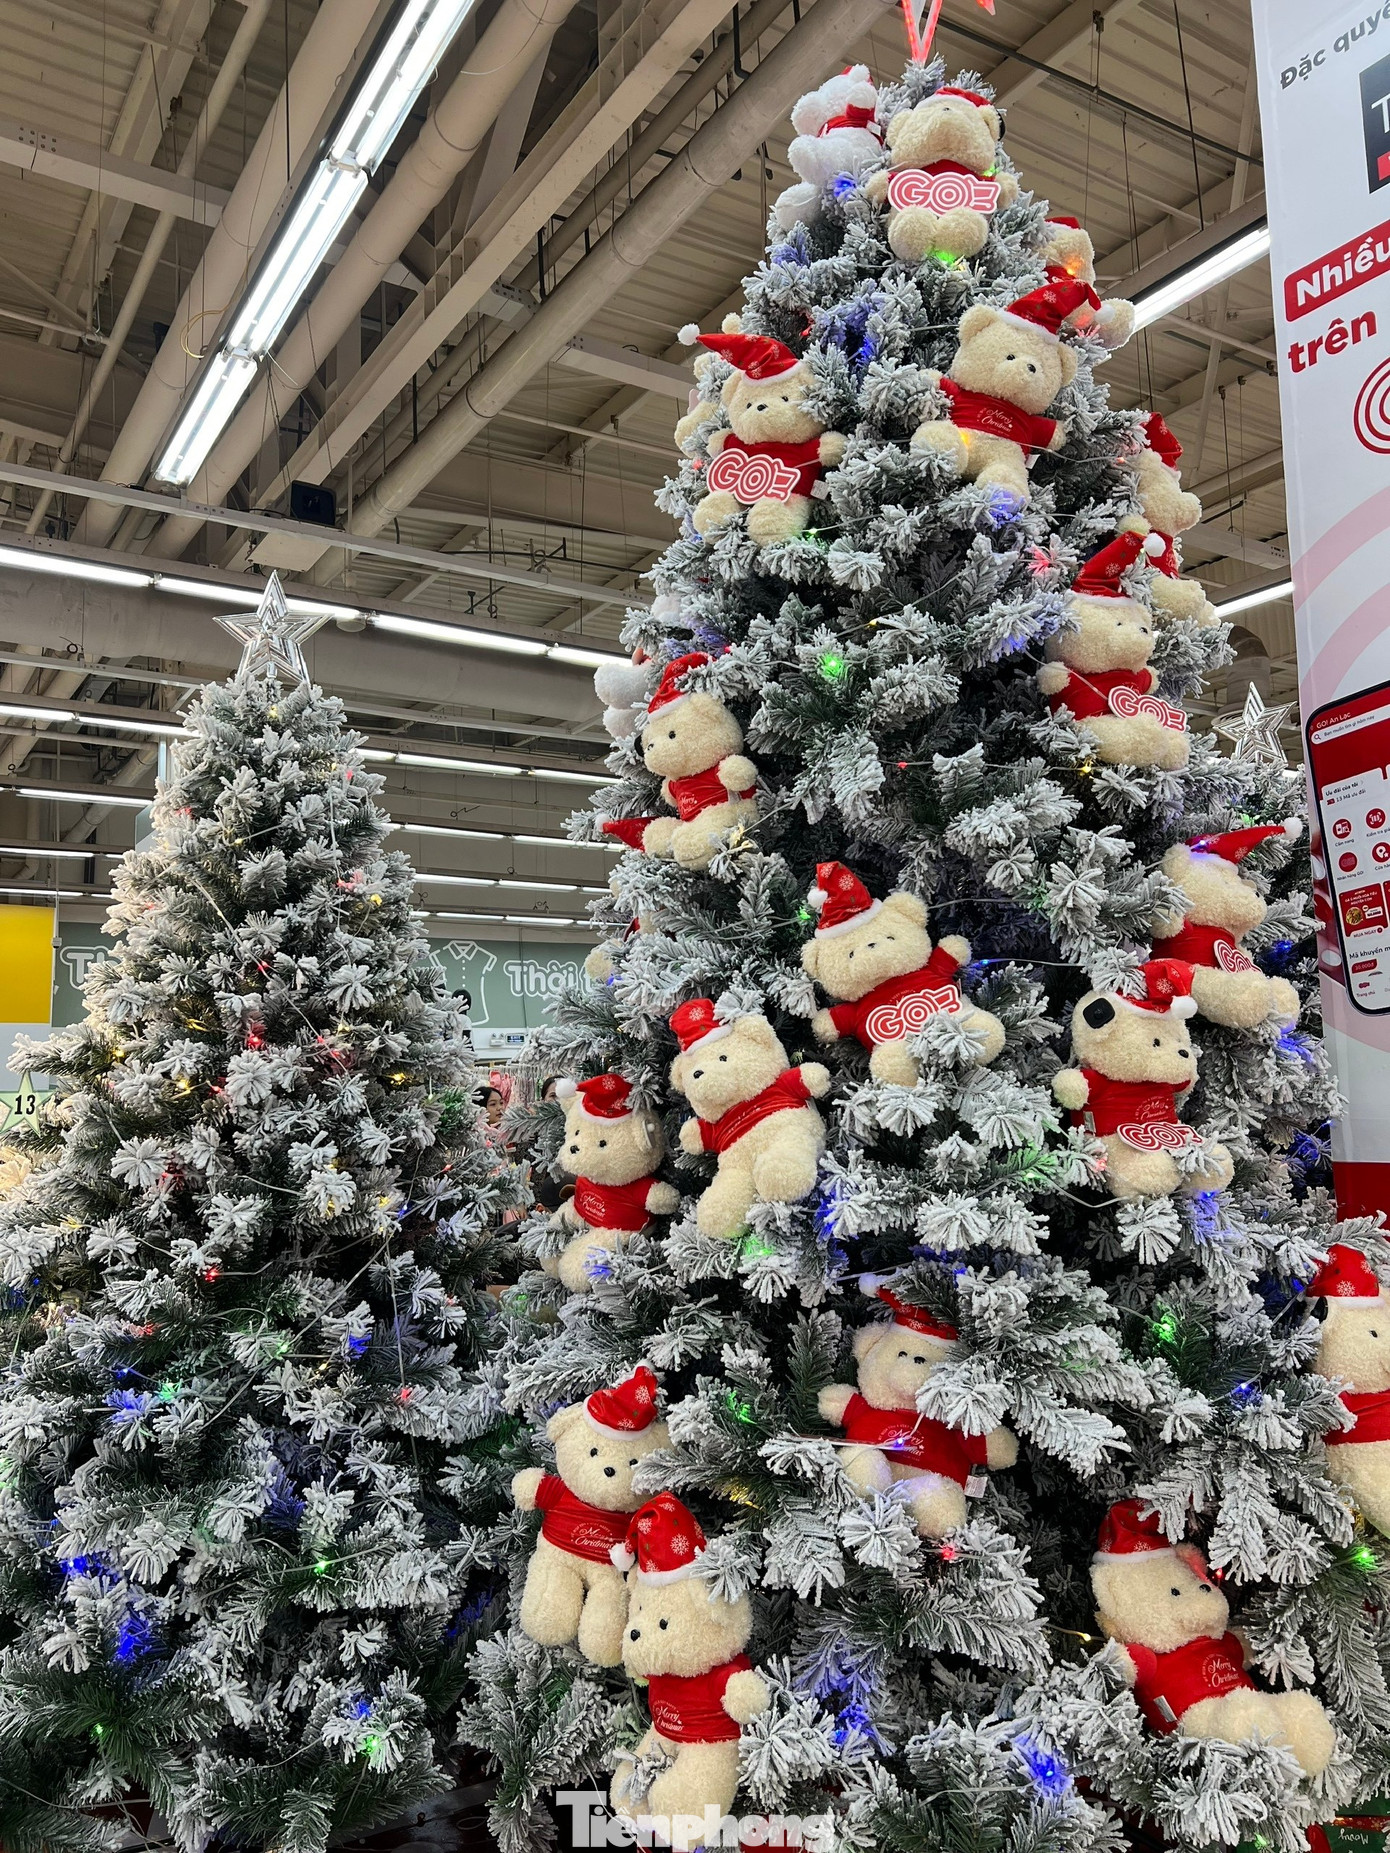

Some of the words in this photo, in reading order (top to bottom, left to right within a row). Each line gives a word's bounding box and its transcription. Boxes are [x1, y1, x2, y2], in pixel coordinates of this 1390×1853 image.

[1280, 54, 1326, 90] Đặc
[1288, 310, 1377, 374] trên
[1360, 946, 1383, 957] khuyến
[506, 961, 576, 995] Thời
[14, 1093, 35, 1115] 13
[1208, 1659, 1231, 1673] Merry
[656, 1706, 680, 1722] Merry
